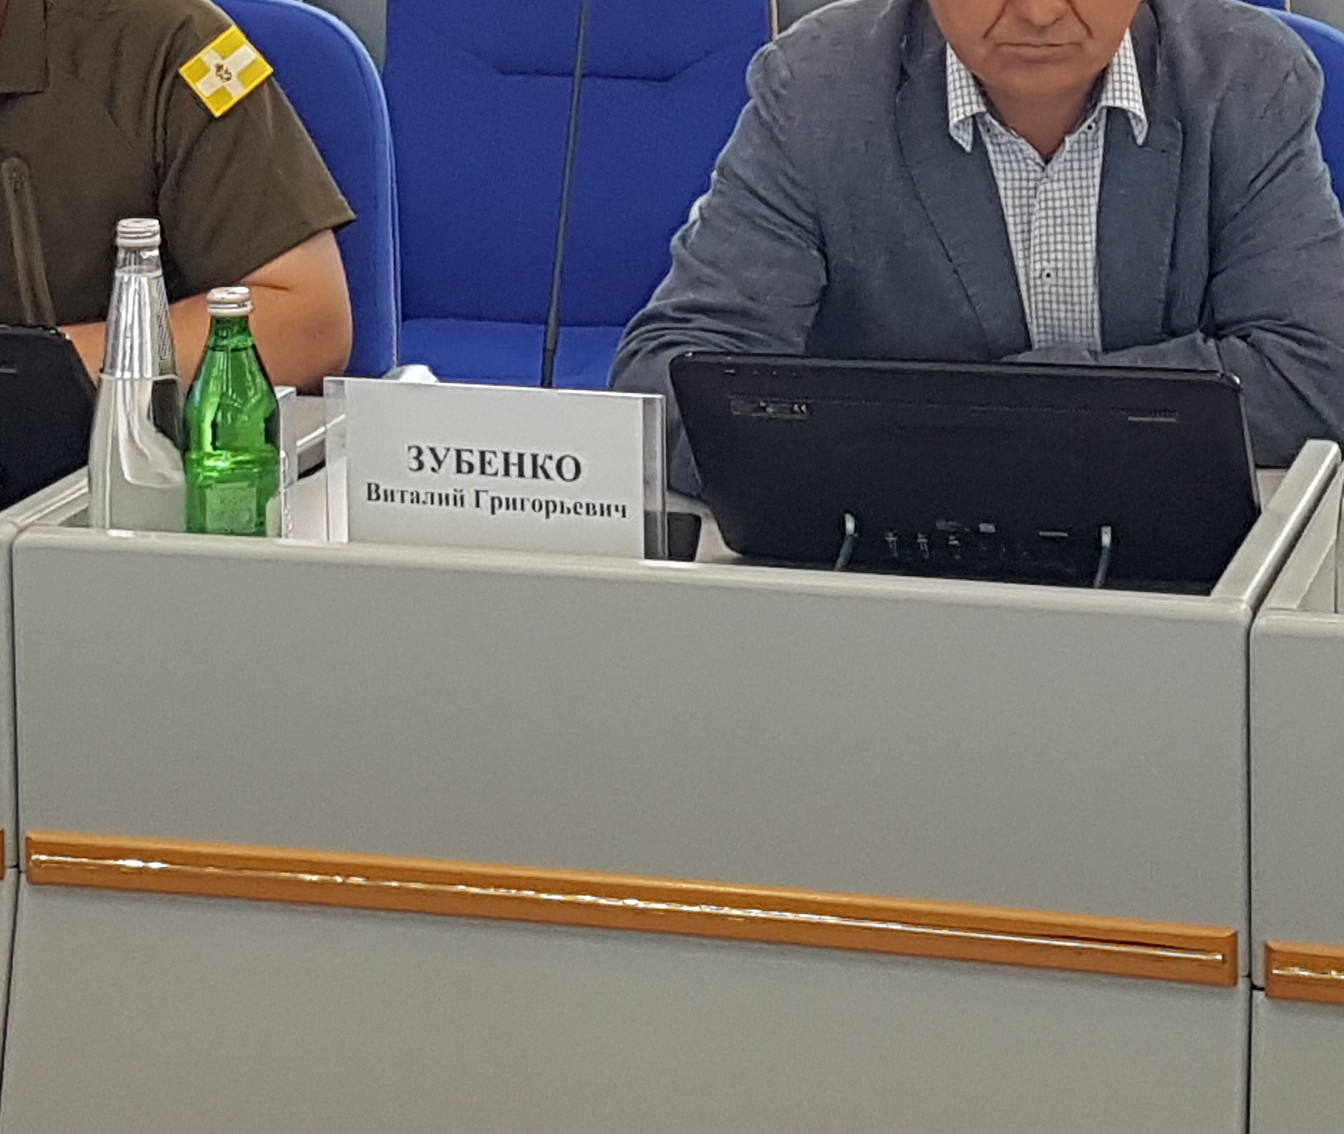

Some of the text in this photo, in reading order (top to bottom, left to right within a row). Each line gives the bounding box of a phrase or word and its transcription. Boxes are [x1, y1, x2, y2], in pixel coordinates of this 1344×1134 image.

[406, 444, 583, 483] ЗУБЕНКО
[365, 481, 628, 520] Виталий Григорьевич
